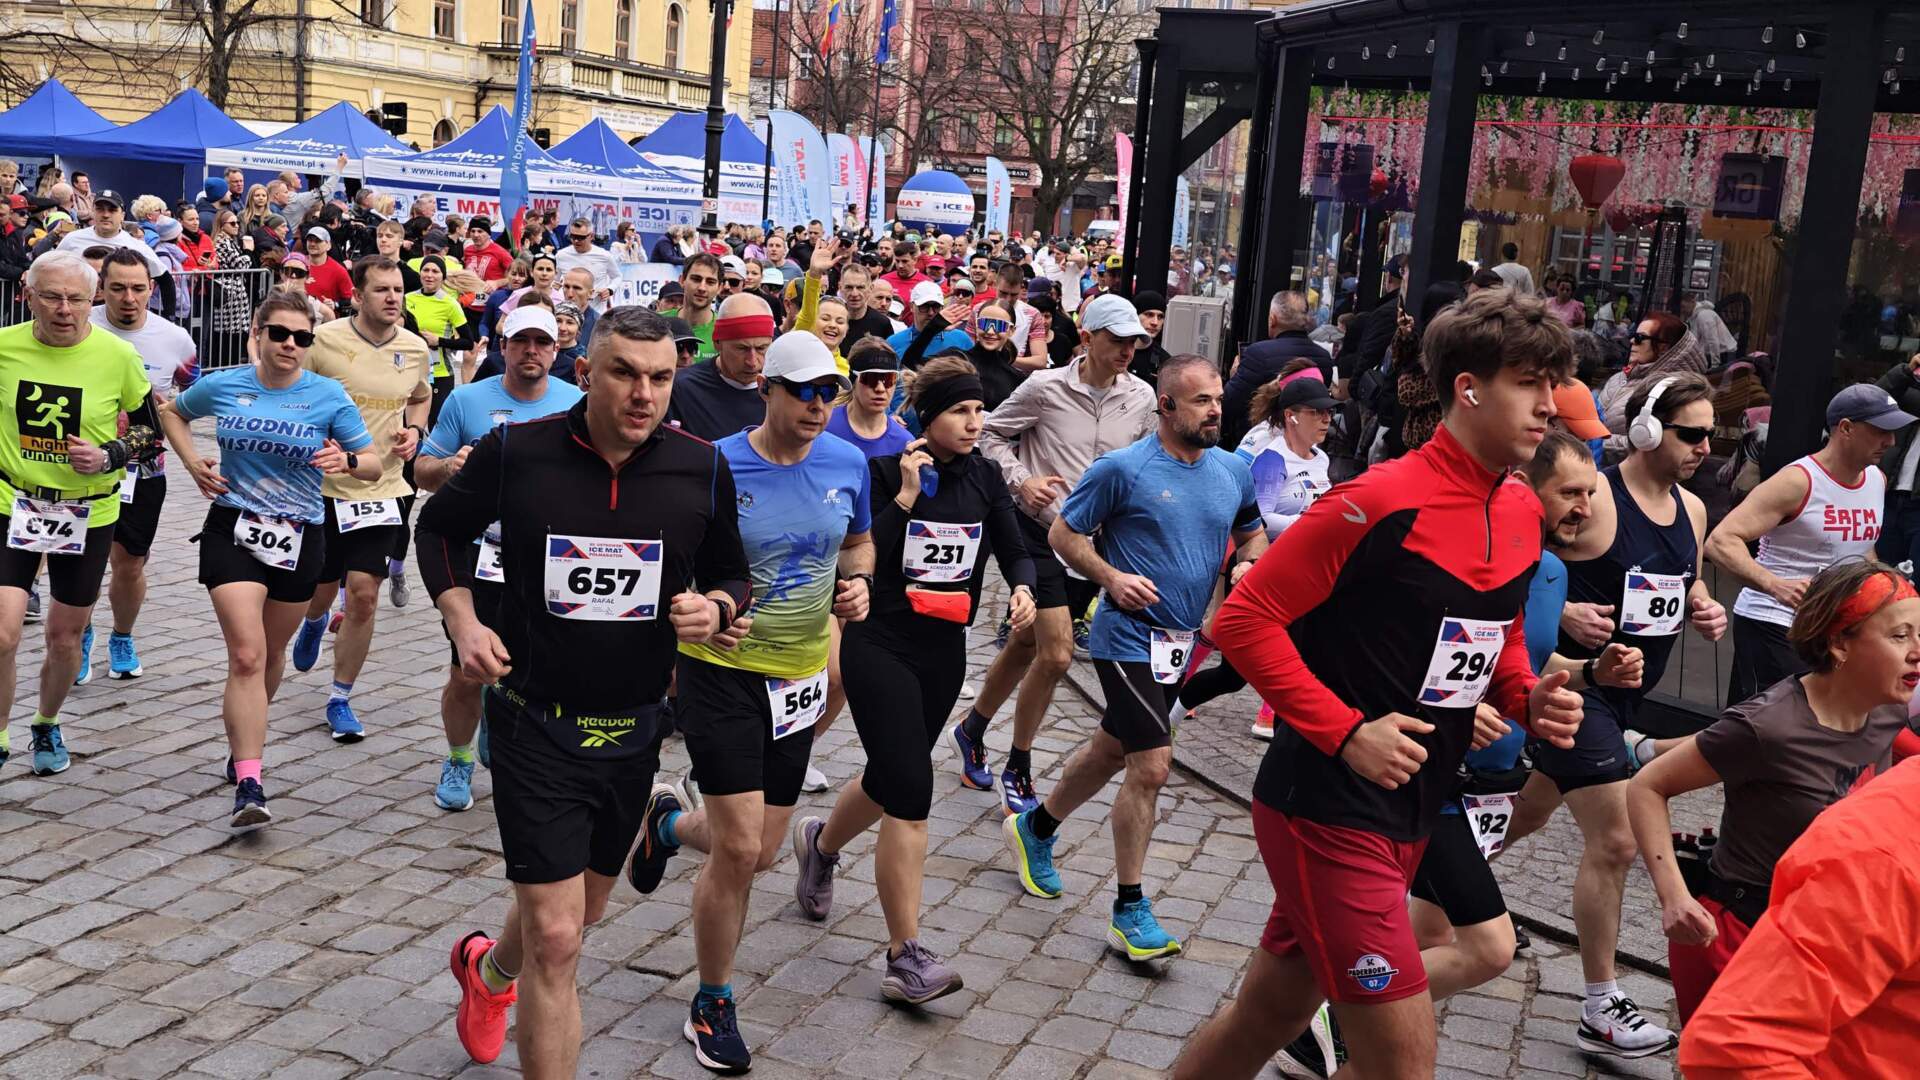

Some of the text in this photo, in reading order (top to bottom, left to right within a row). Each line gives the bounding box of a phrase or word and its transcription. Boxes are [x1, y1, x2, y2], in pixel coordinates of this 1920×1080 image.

[252, 156, 315, 168] www.icemat.pl
[728, 163, 758, 171] ICE
[411, 166, 477, 179] www.icemat.pl
[556, 177, 597, 188] www.icemat.pl
[652, 185, 690, 194] www.icemat.pl
[730, 181, 778, 191] www.icm
[457, 199, 500, 216] MAT
[637, 280, 658, 296] ICE
[31, 438, 69, 453] night
[350, 501, 385, 517] 153
[244, 526, 292, 553] 304
[923, 543, 965, 564] 231
[567, 566, 641, 596] 657
[1648, 596, 1680, 618] 80
[1170, 648, 1188, 667] 8
[785, 680, 822, 715] 564
[1475, 813, 1508, 835] 82
[1348, 966, 1386, 976] PADERBORN
